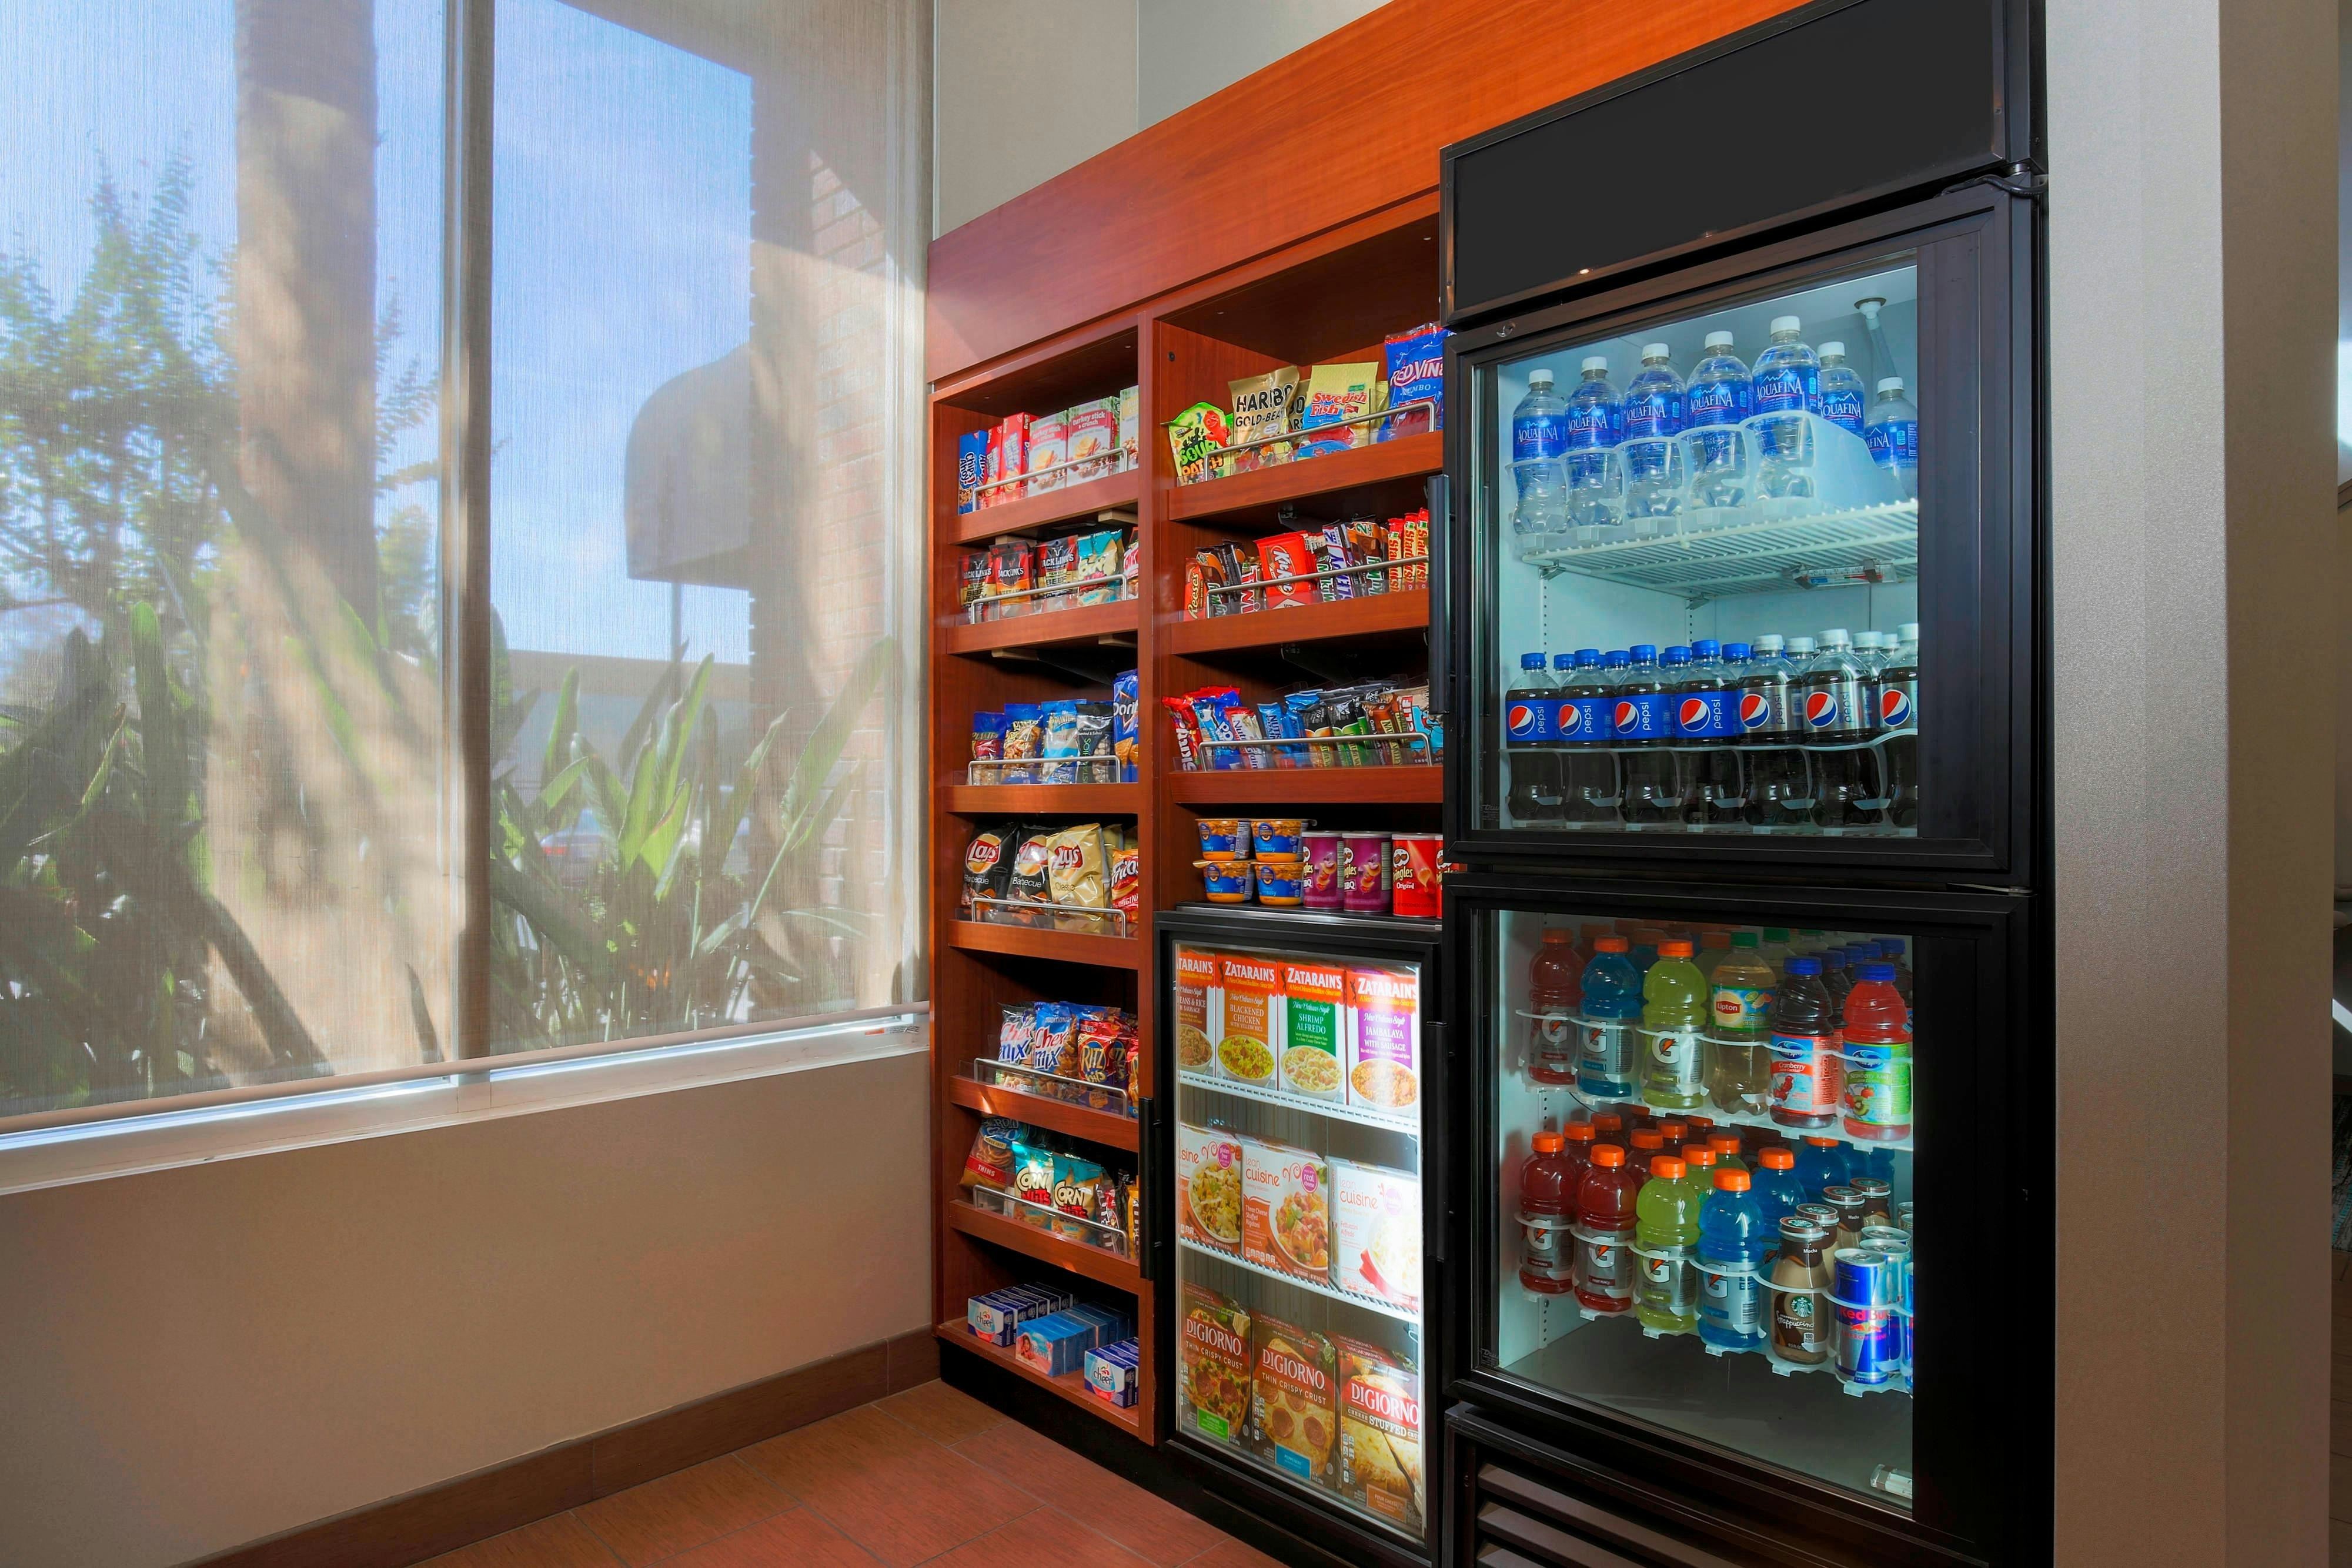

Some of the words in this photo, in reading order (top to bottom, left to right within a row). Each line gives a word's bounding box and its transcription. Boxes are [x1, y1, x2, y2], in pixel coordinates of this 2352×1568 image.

[1756, 376, 1803, 401] AQUAFINA
[1312, 392, 1367, 404] Swedish
[1690, 392, 1733, 413] AQUAFINA
[1073, 415, 1091, 426] turkey
[1091, 412, 1105, 420] stick
[1235, 410, 1283, 427] GOLD-BEA
[1310, 404, 1339, 417] Fish
[1626, 405, 1667, 423] AQUAFINA
[1823, 403, 1862, 419] QUAFINA
[1082, 420, 1098, 428] crunch
[1568, 414, 1608, 433] AQUAFINA
[1518, 425, 1558, 442] AQUAFINA
[1867, 432, 1889, 449] AFINA
[1179, 441, 1217, 465] SOUR
[960, 459, 970, 484] Ahoy!
[1182, 455, 1224, 482] PATH
[1357, 524, 1367, 534] 2
[1404, 530, 1415, 586] Starurst
[1416, 529, 1428, 585] Starurst
[1389, 540, 1401, 592] Staurst
[1188, 573, 1200, 619] Reese's
[1114, 703, 1138, 716] Dorit
[1402, 696, 1414, 732] CLIF
[1640, 701, 1652, 731] pepsi
[1711, 698, 1723, 729] pepsi
[1775, 694, 1785, 725] pepsi
[1843, 691, 1852, 724] pepsi
[1536, 706, 1546, 734] pepsi
[1583, 705, 1593, 734] pepsi
[1082, 738, 1091, 783] ISTAHIOS
[968, 841, 998, 862] Lay's
[1052, 846, 1080, 870] Lay's
[1013, 877, 1042, 888] Barbecue
[1393, 867, 1413, 881] ringles
[1396, 882, 1414, 890] Original
[1118, 897, 1138, 907] ORIGIN
[1177, 958, 1213, 974] TARAIN'S
[1225, 961, 1275, 982] ZATARAIN'S
[1287, 967, 1342, 989] ZATARAIN'S
[1179, 996, 1191, 1005] EANS
[1195, 999, 1206, 1008] RICE
[1230, 1004, 1264, 1017] BLACKENED
[1717, 1004, 1738, 1012] Lipton
[1233, 1014, 1261, 1025] CHICKEN
[1299, 1013, 1324, 1025] SHRIMP
[1297, 1022, 1326, 1035] ALFREDO
[1365, 1026, 1404, 1039] JAMBALAYA
[1035, 1028, 1068, 1049] Chex
[1364, 1039, 1379, 1048] WITH
[1380, 1041, 1406, 1052] SAUSAGE
[1081, 1045, 1104, 1072] RITZ
[1779, 1062, 1806, 1071] Cranberry
[1181, 1148, 1199, 1164] sine
[1245, 1155, 1261, 1168] lean
[978, 1164, 995, 1176] THINS
[1246, 1168, 1279, 1187] cuisine
[1304, 1174, 1315, 1182] real
[1016, 1166, 1047, 1192] CORN
[1339, 1175, 1356, 1189] lean
[1054, 1181, 1085, 1206] CORN
[1340, 1189, 1378, 1209] cuisine
[1256, 1207, 1268, 1216] Cheese
[977, 1315, 993, 1328] cheer
[1840, 1309, 1867, 1321] Red
[1186, 1340, 1199, 1352] THIN
[1201, 1347, 1222, 1362] CRISPY
[1224, 1356, 1242, 1371] CRUST
[1093, 1369, 1112, 1386] cheer
[1262, 1372, 1277, 1385] THIN
[1279, 1380, 1302, 1396] CRISPY
[1304, 1390, 1326, 1406] CRUST
[1348, 1407, 1368, 1421] CHEESE
[1369, 1415, 1407, 1437] STUFFED
[1407, 1430, 1418, 1440] CRU
